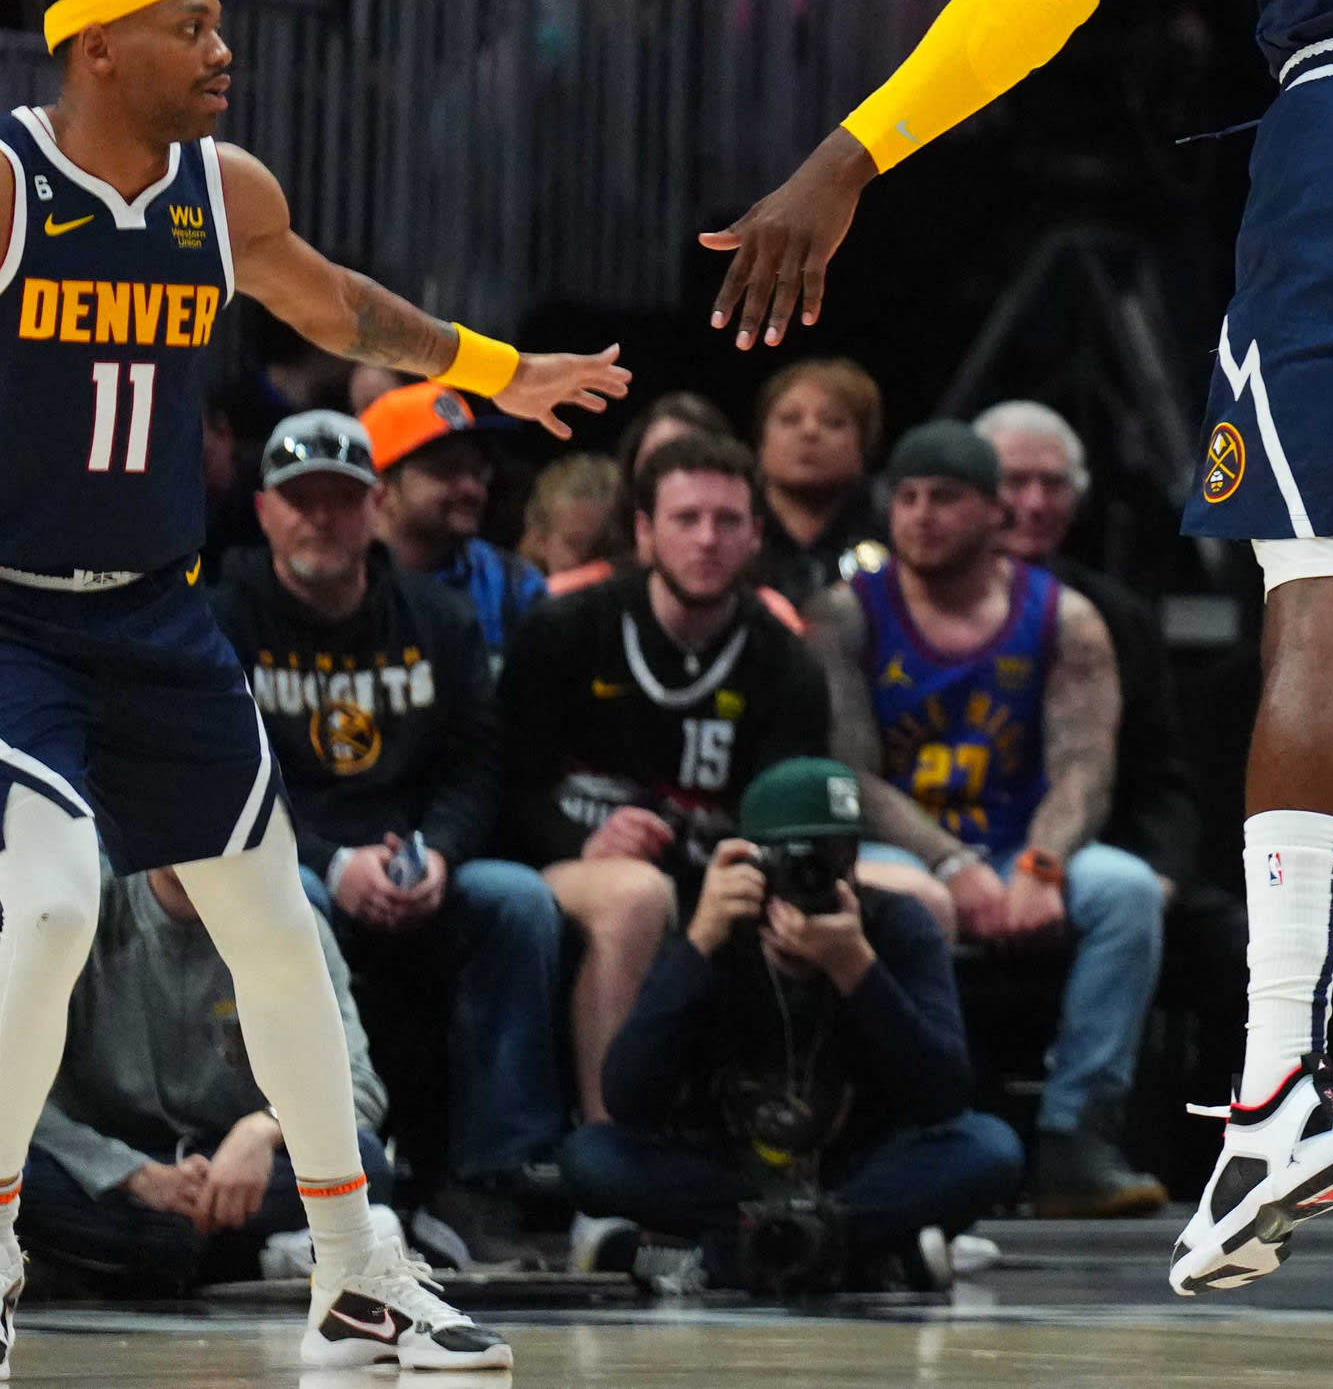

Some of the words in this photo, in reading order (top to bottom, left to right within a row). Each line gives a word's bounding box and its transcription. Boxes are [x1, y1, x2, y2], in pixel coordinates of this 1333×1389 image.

[34, 174, 54, 201] 6
[169, 204, 203, 228] WU
[18, 277, 220, 347] DENVER
[87, 360, 157, 473] 11
[678, 717, 735, 792] 15
